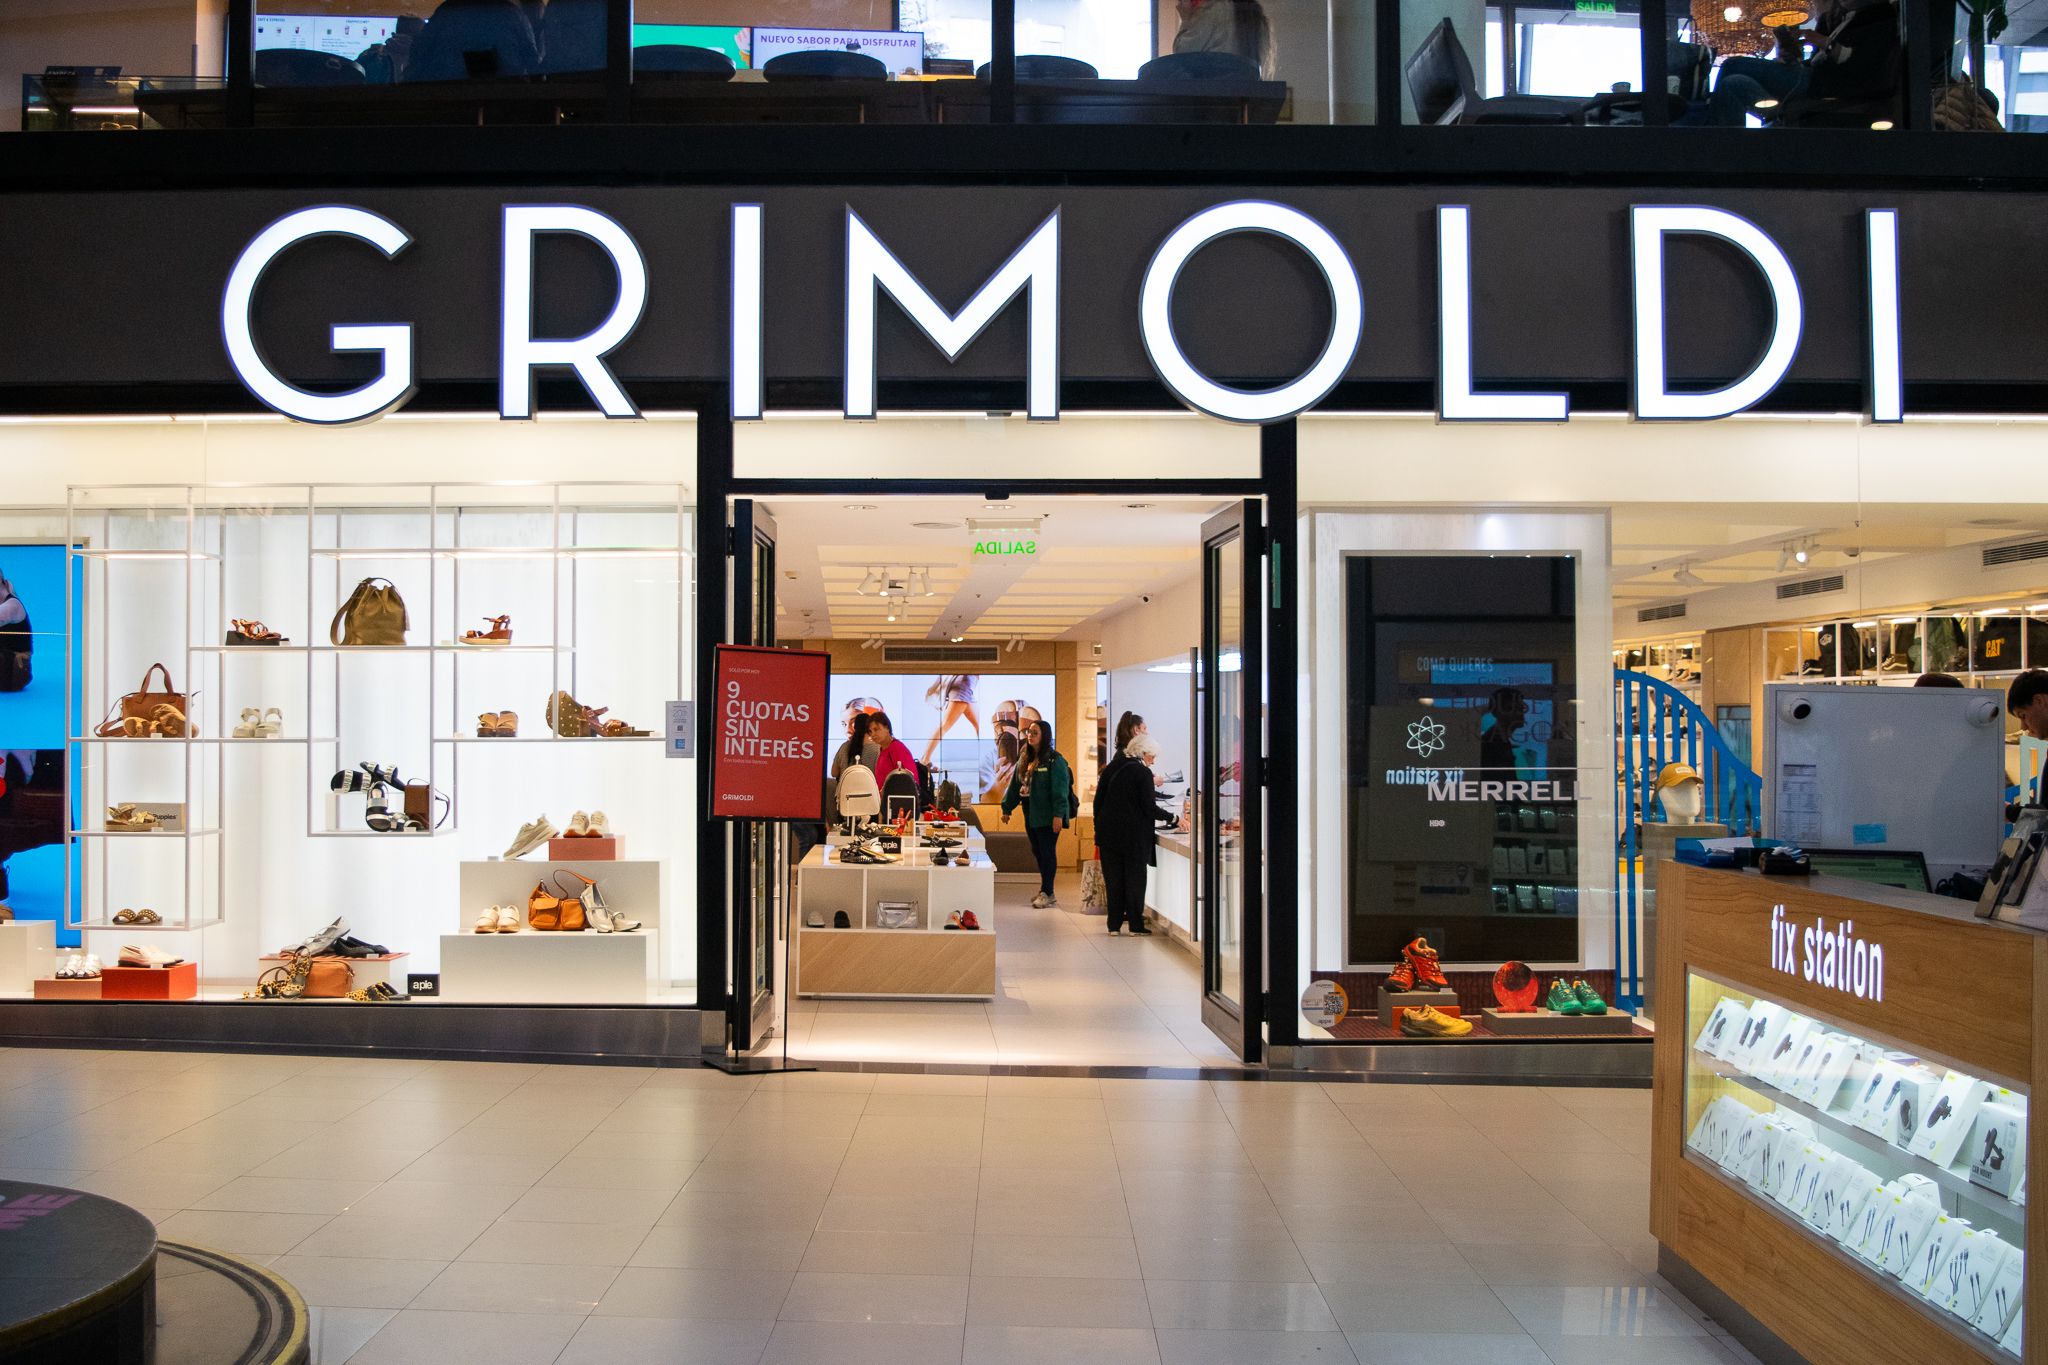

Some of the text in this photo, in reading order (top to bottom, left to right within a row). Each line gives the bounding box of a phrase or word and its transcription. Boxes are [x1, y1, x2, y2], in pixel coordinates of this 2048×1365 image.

[1576, 2, 1614, 13] SALIDA
[760, 35, 917, 48] NUEVO SABOR PARA DISFRUTAR
[221, 203, 1905, 424] GRIMOLDI
[1416, 657, 1494, 672] COMO QUIERES
[727, 680, 741, 699] 9
[726, 700, 810, 722] CUOTAS
[725, 719, 760, 738] SIN
[725, 736, 814, 760] INTERÉS
[722, 793, 754, 801] GRIMOLDI
[1427, 780, 1593, 802] MERRELL
[1429, 819, 1446, 828] HBO
[1771, 904, 1884, 1003] fix station
